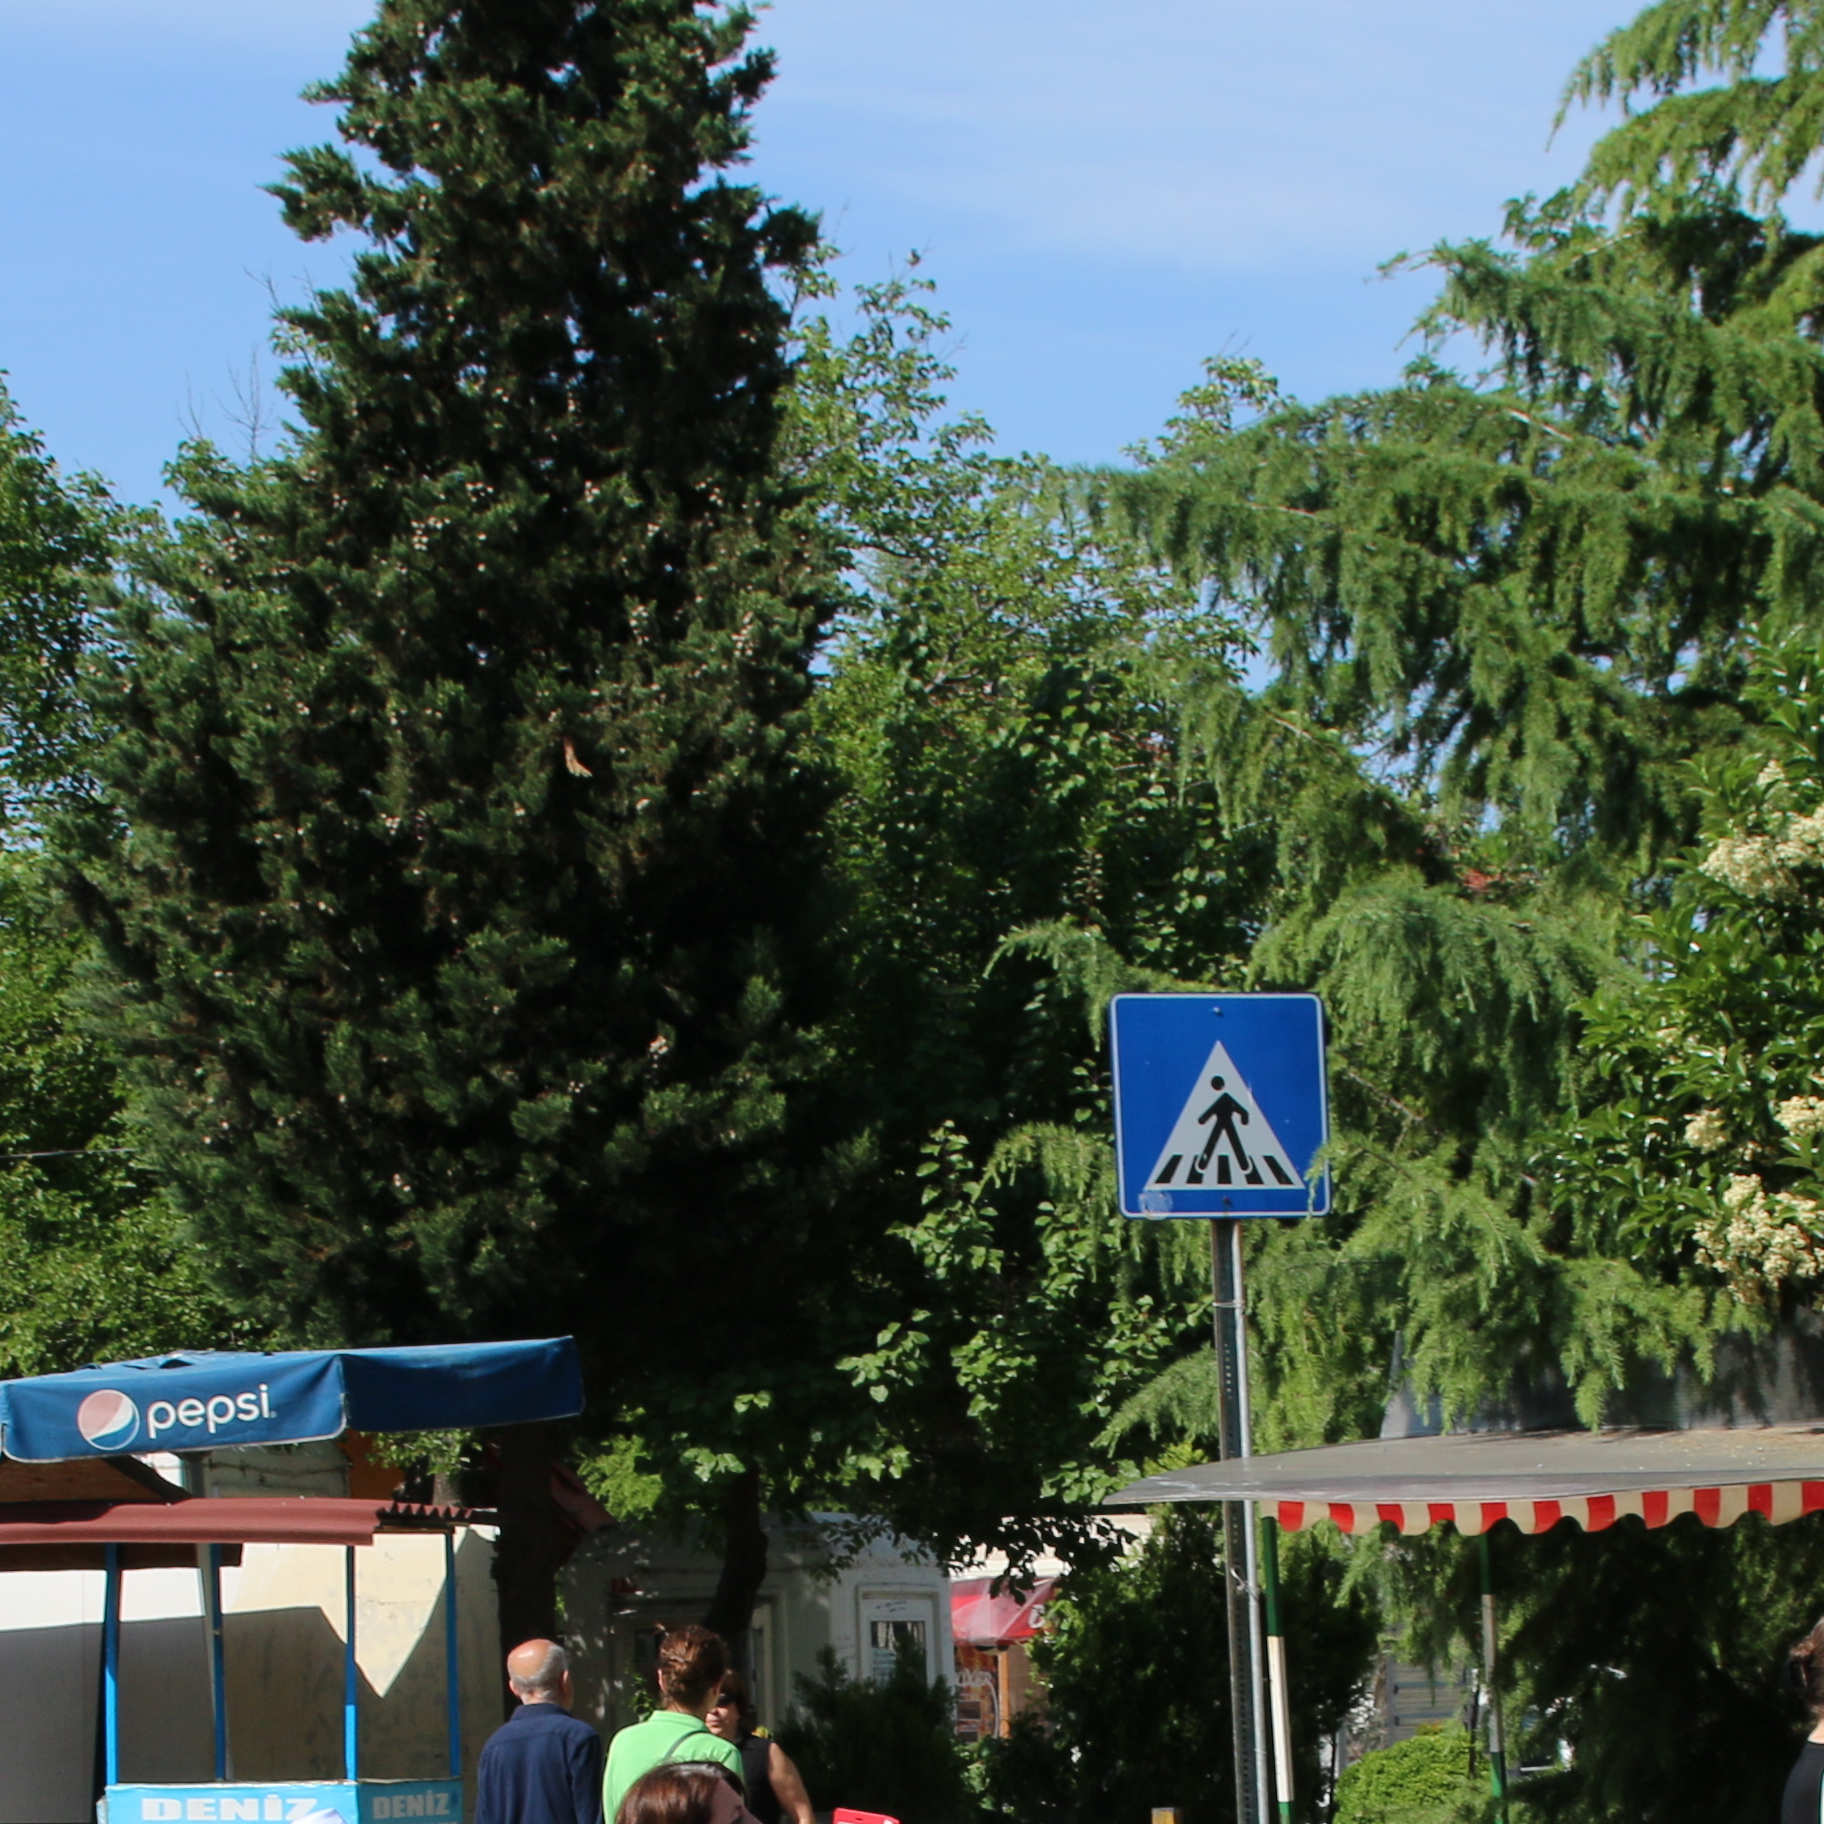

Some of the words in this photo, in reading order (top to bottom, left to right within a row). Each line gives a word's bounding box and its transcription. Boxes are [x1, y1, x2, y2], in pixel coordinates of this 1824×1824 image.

[146, 1383, 270, 1439] pepsi
[141, 1794, 319, 1821] DENİZ
[373, 1790, 451, 1819] DENİZ
